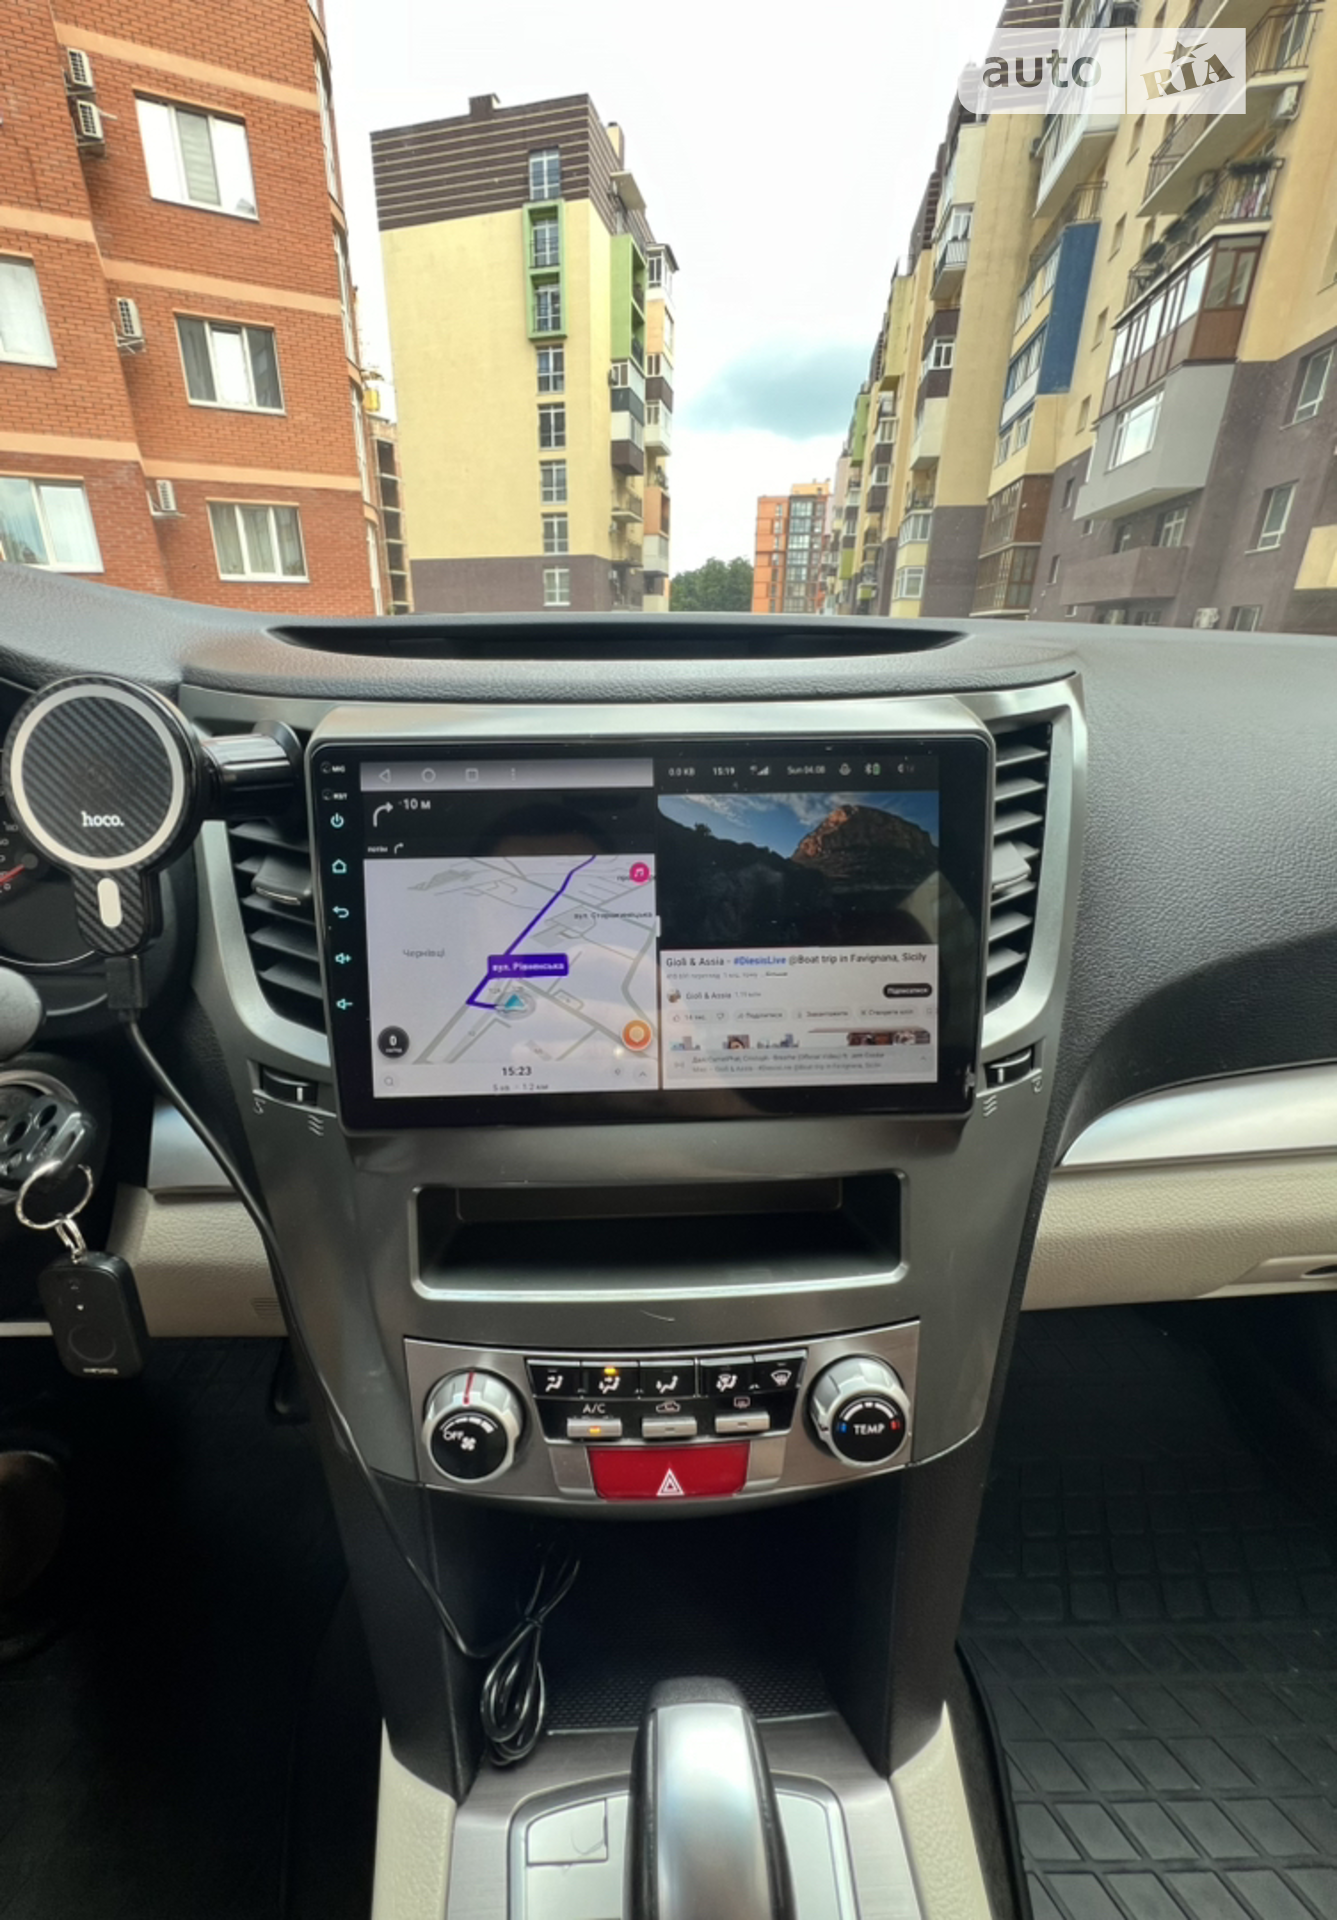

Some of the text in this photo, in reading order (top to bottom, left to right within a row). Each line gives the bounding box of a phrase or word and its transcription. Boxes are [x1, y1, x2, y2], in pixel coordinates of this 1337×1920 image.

[331, 765, 346, 773] MIC
[683, 766, 696, 776] KB
[712, 766, 736, 776] 15:19
[333, 792, 348, 800] RST
[403, 798, 418, 810] 10
[81, 811, 125, 827] hoco.
[698, 957, 725, 967] Assia
[821, 953, 838, 965] trip
[839, 953, 849, 963] in
[901, 951, 928, 963] Sicily
[388, 1034, 398, 1047] 0
[502, 1066, 532, 1076] 15:23
[582, 1402, 606, 1414] A/C
[853, 1422, 886, 1436] TEMP
[443, 1430, 465, 1441] OFF
